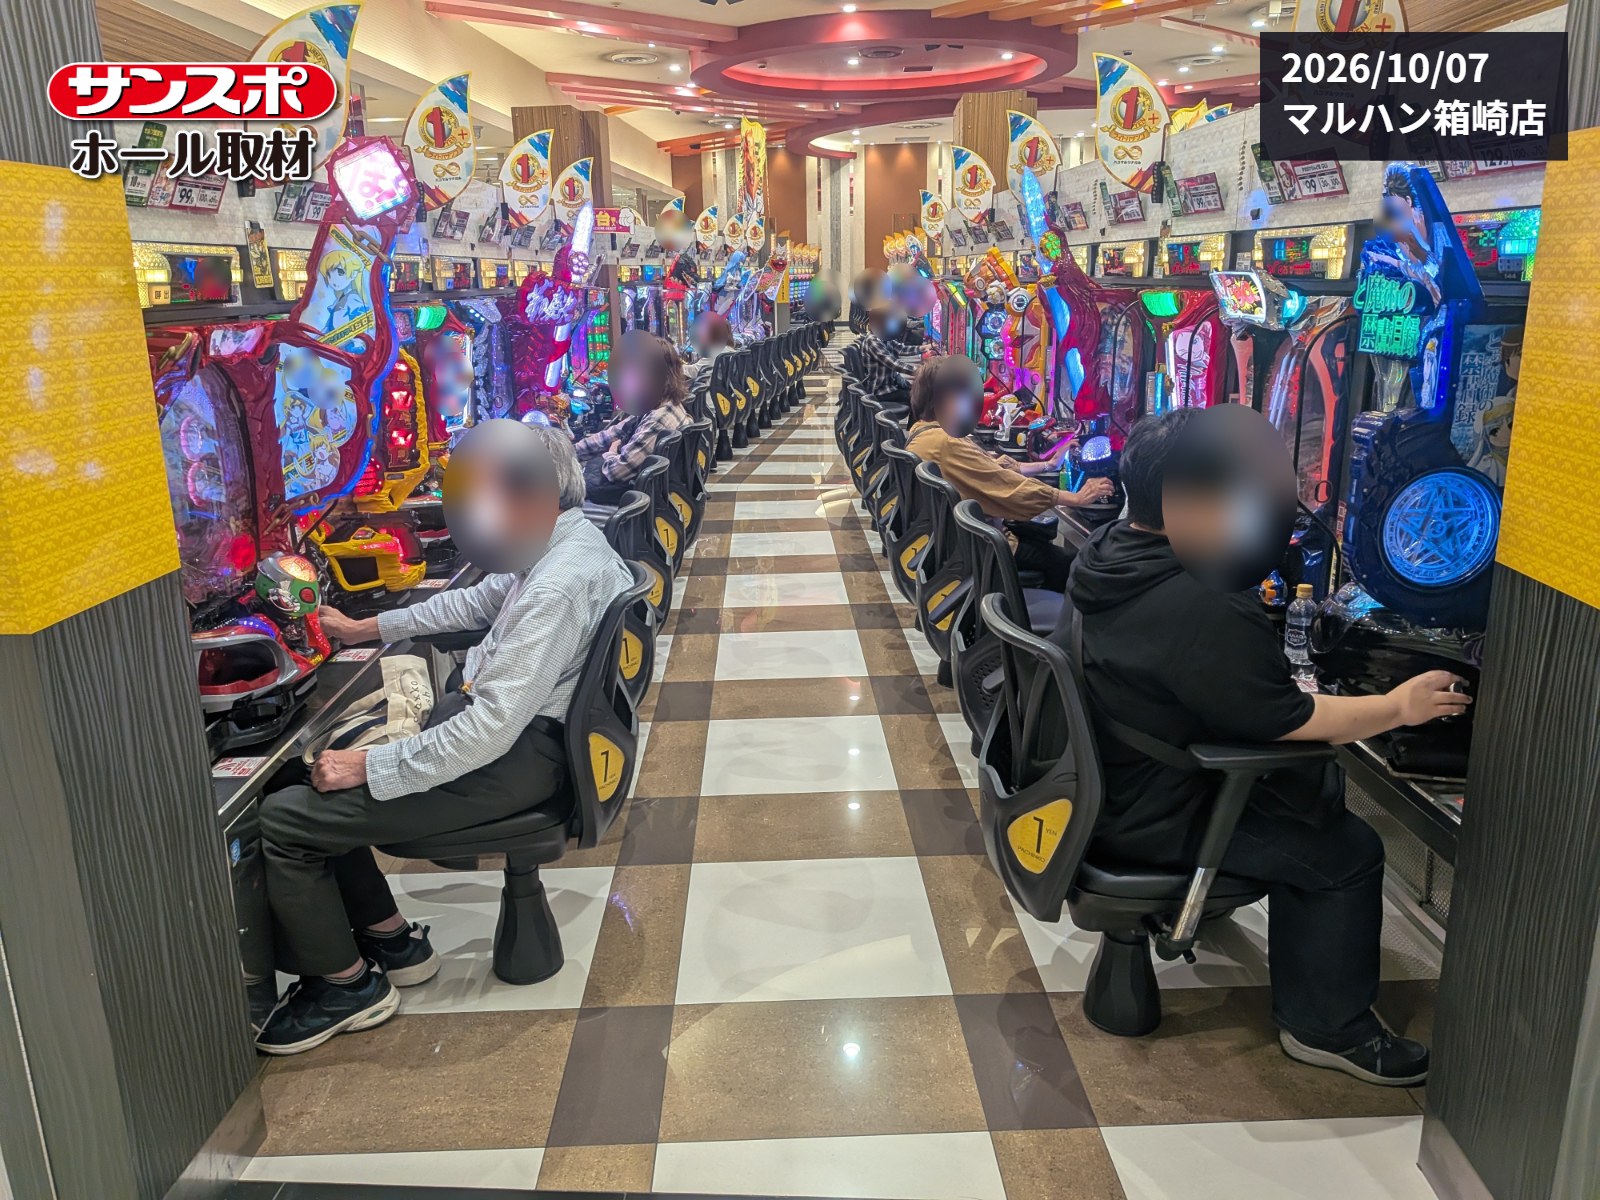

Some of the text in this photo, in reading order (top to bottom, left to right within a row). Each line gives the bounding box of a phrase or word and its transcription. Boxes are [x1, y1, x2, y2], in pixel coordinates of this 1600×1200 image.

[1121, 87, 1139, 129] 1
[426, 107, 446, 148] 1
[1026, 137, 1040, 168] 1
[517, 154, 531, 184] 1
[968, 165, 978, 190] 1
[565, 177, 577, 201] 1
[622, 637, 629, 664] 1
[600, 750, 610, 783] 1
[1033, 816, 1044, 854] 1
